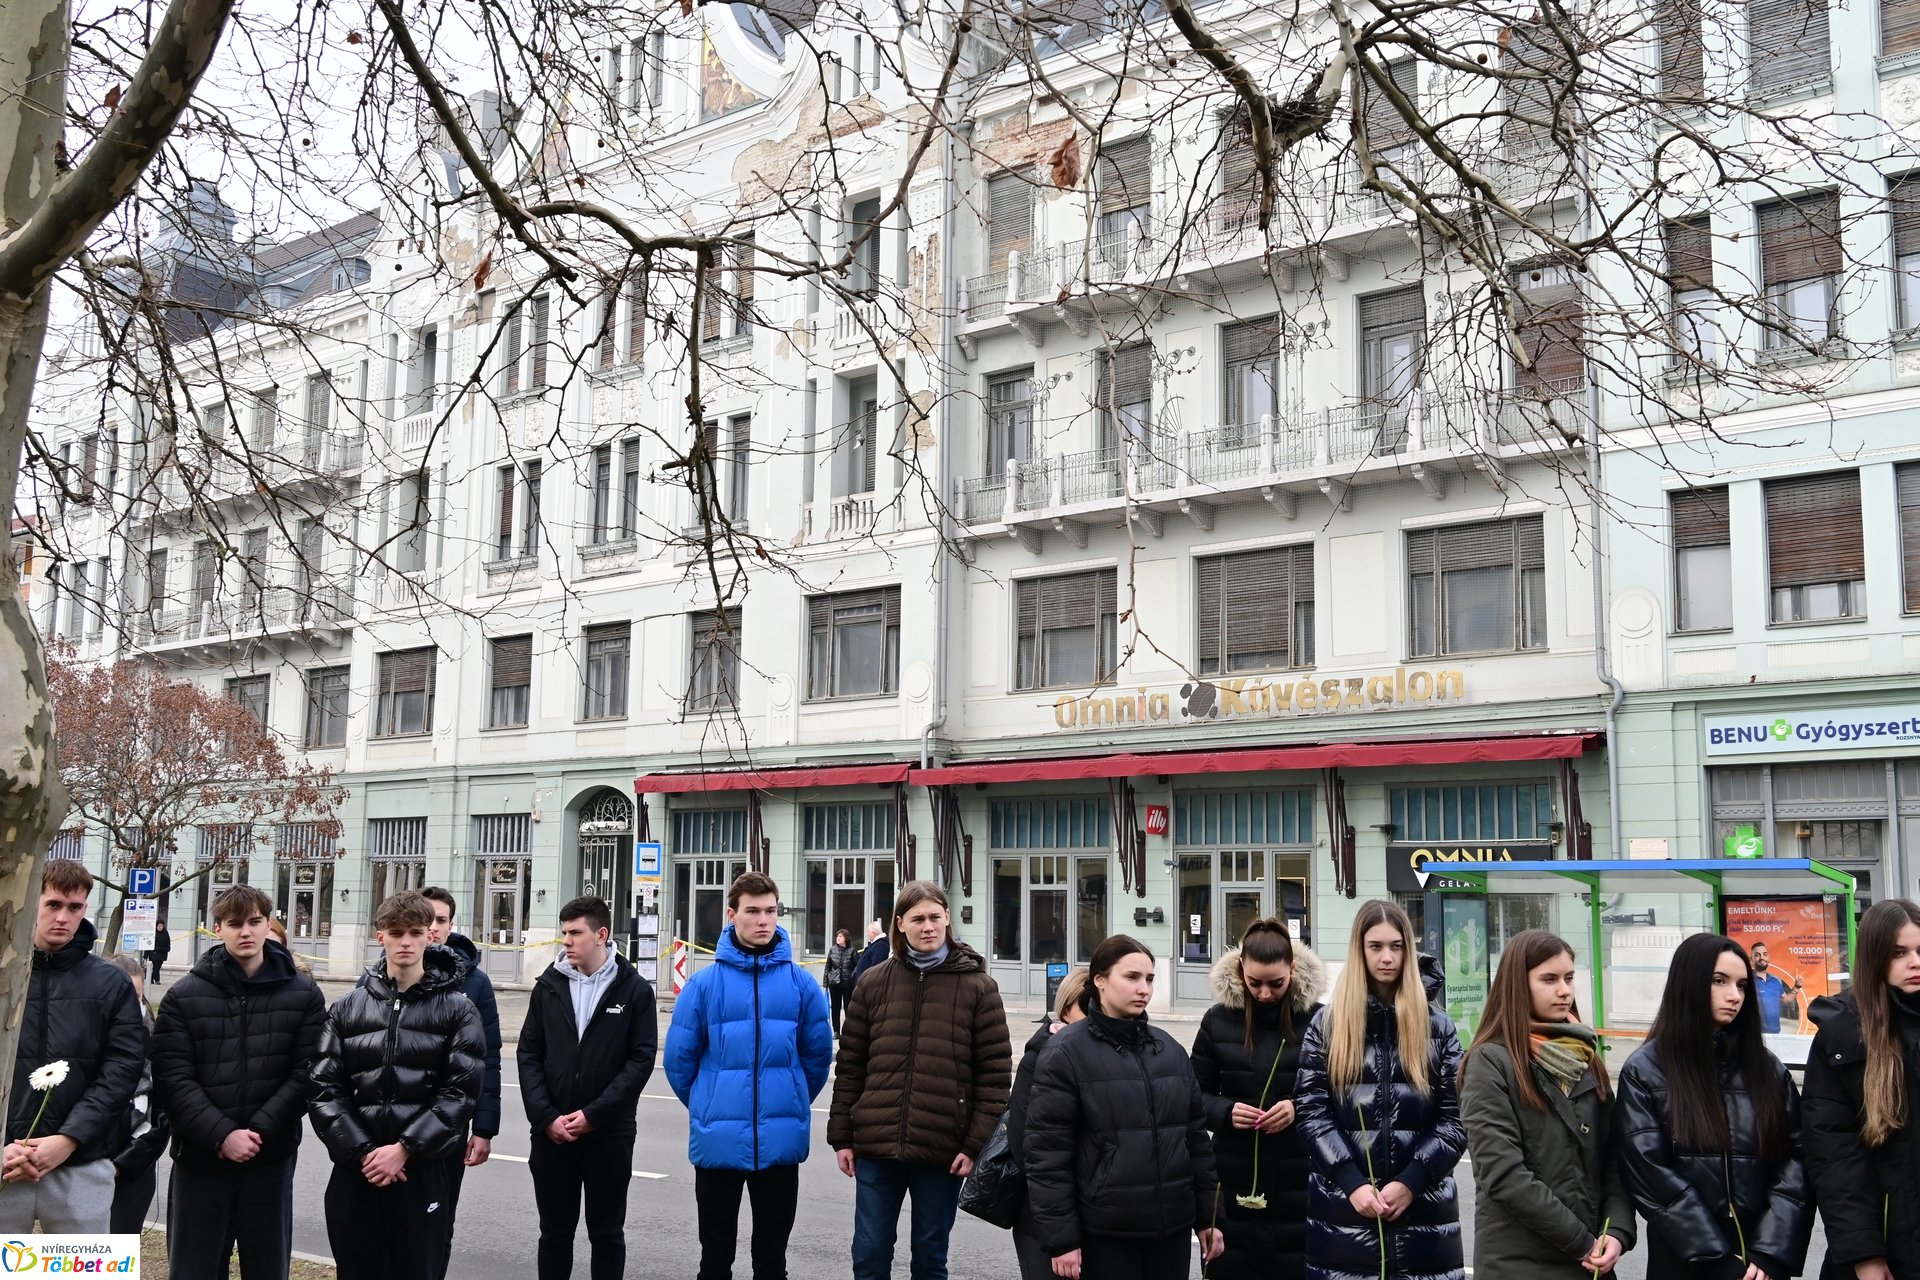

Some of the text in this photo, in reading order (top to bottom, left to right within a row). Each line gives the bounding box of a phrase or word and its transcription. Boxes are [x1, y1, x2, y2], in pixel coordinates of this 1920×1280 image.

[1055, 667, 1465, 728] Omnia Kávészalon
[1710, 725, 1768, 745] BENU
[1148, 809, 1167, 833] illy
[134, 870, 151, 893] P
[1439, 880, 1477, 888] GELA
[128, 901, 135, 910] P
[1728, 905, 1777, 915] EMELTÜNK!
[1743, 925, 1771, 933] 53.000
[1788, 946, 1823, 955] 102.000
